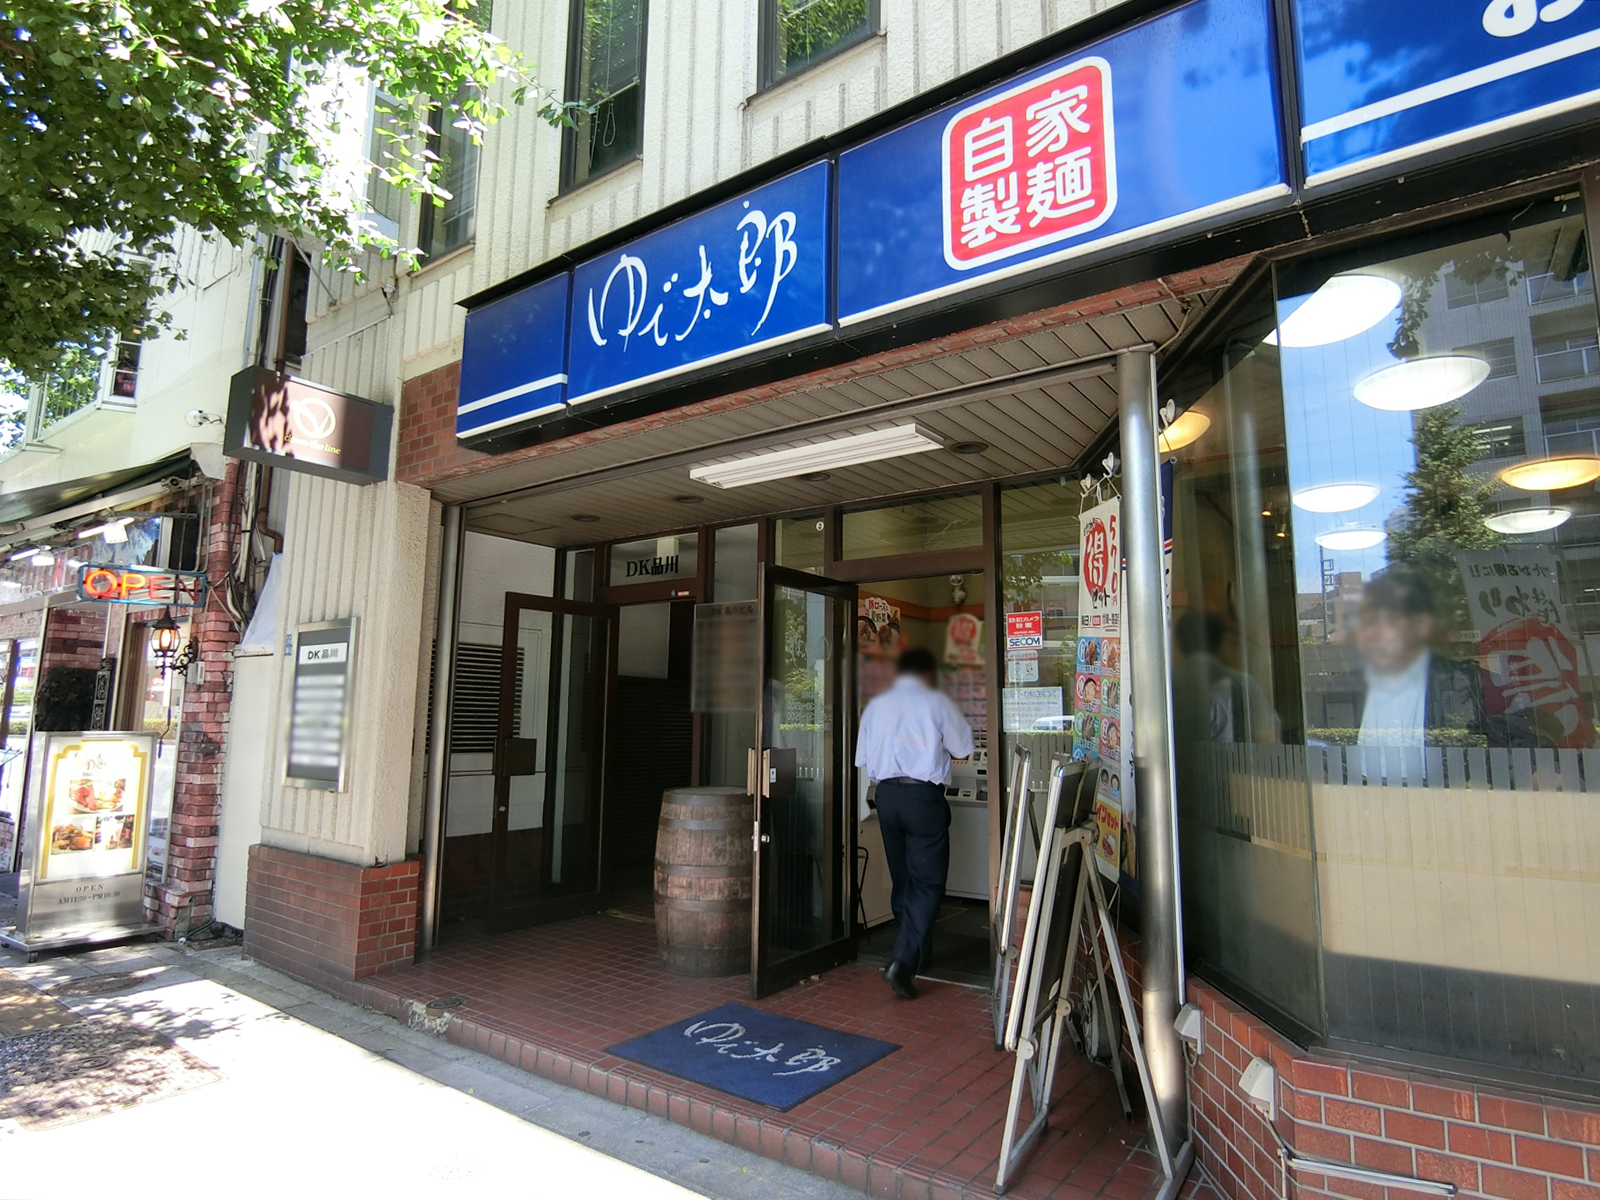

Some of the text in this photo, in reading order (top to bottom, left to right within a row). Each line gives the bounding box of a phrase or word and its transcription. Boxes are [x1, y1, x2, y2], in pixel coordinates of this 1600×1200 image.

[324, 443, 342, 455] line
[626, 554, 679, 577] DK品川
[84, 570, 199, 602] OPEN
[1009, 637, 1041, 647] SECOM
[307, 648, 338, 660] DK 品川
[76, 884, 104, 892] OPEN
